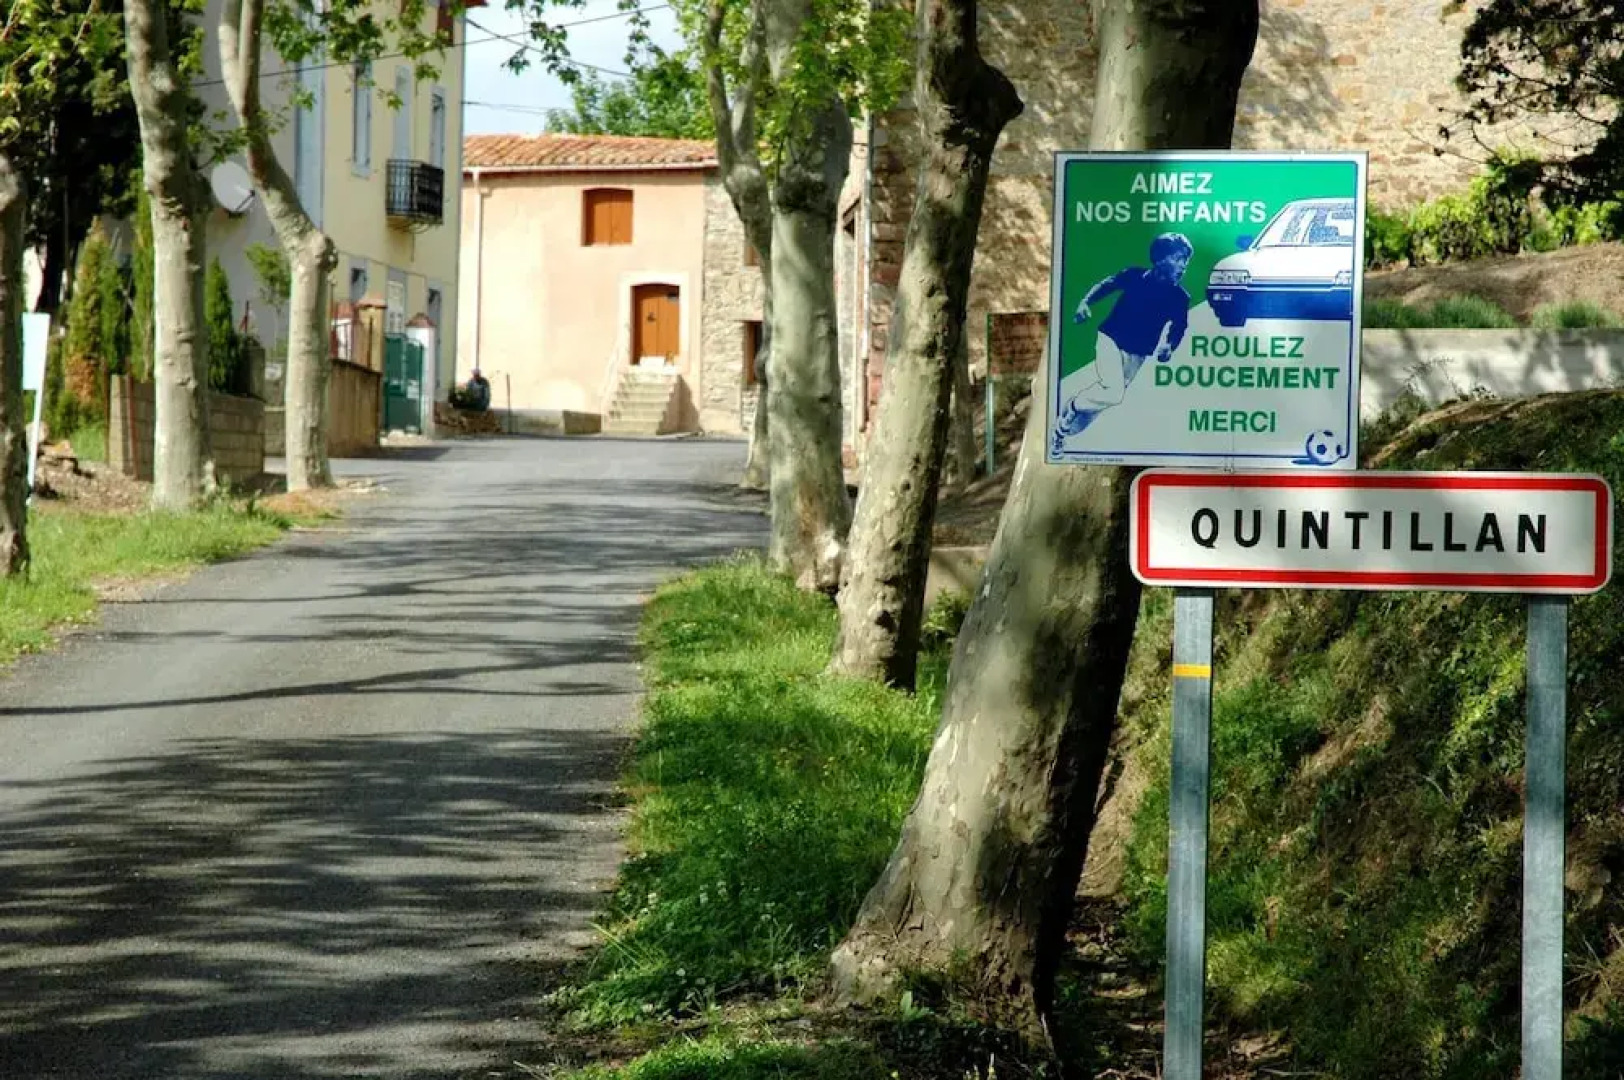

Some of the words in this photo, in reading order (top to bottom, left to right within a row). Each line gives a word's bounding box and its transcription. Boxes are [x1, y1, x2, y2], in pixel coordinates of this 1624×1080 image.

[1130, 172, 1213, 194] AIMEZ
[1076, 202, 1131, 222] NOS
[1142, 202, 1266, 222] ENFANTS
[1191, 337, 1304, 357] ROULEZ
[1155, 367, 1340, 388] DOUCEMENT
[1188, 411, 1276, 432] MERCI
[1191, 508, 1548, 553] QUINTILLAN
